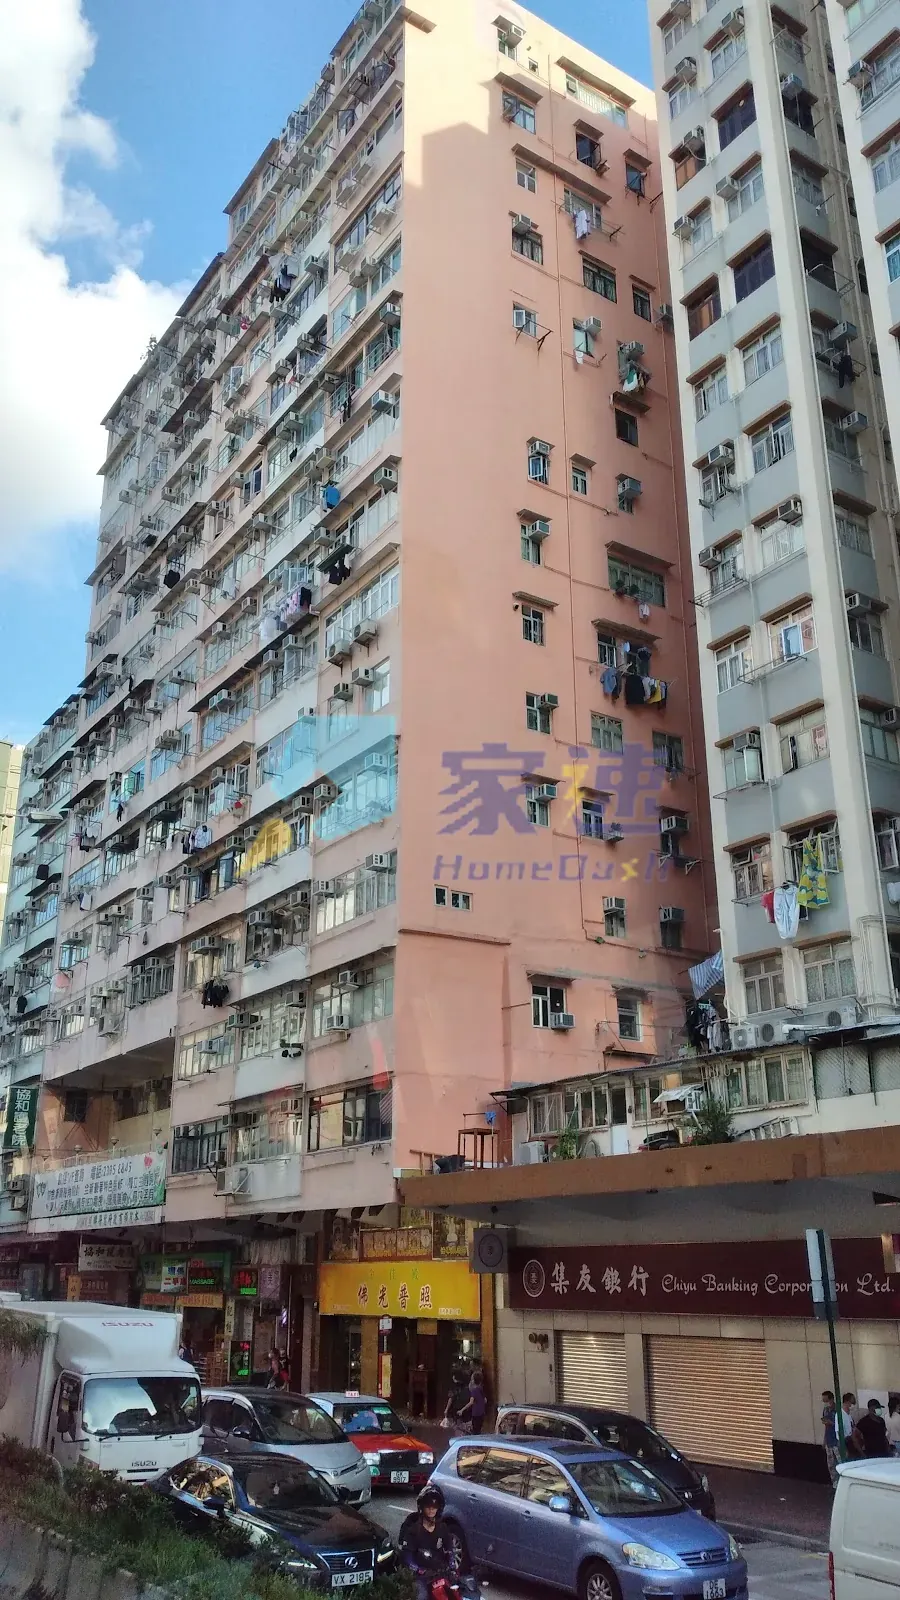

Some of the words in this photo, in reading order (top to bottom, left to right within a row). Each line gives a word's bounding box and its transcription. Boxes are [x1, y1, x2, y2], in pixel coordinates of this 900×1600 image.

[11, 1088, 31, 1146] 協和護老院
[550, 1261, 650, 1296] 集友銀行
[661, 1273, 698, 1293] Chiyu
[701, 1274, 759, 1296] Banking
[764, 1273, 849, 1298] Corporon
[857, 1272, 895, 1296] Ltd.
[357, 1283, 433, 1310] 佛光普照
[333, 1575, 346, 1584] VX
[706, 1587, 724, 1599] 1663
